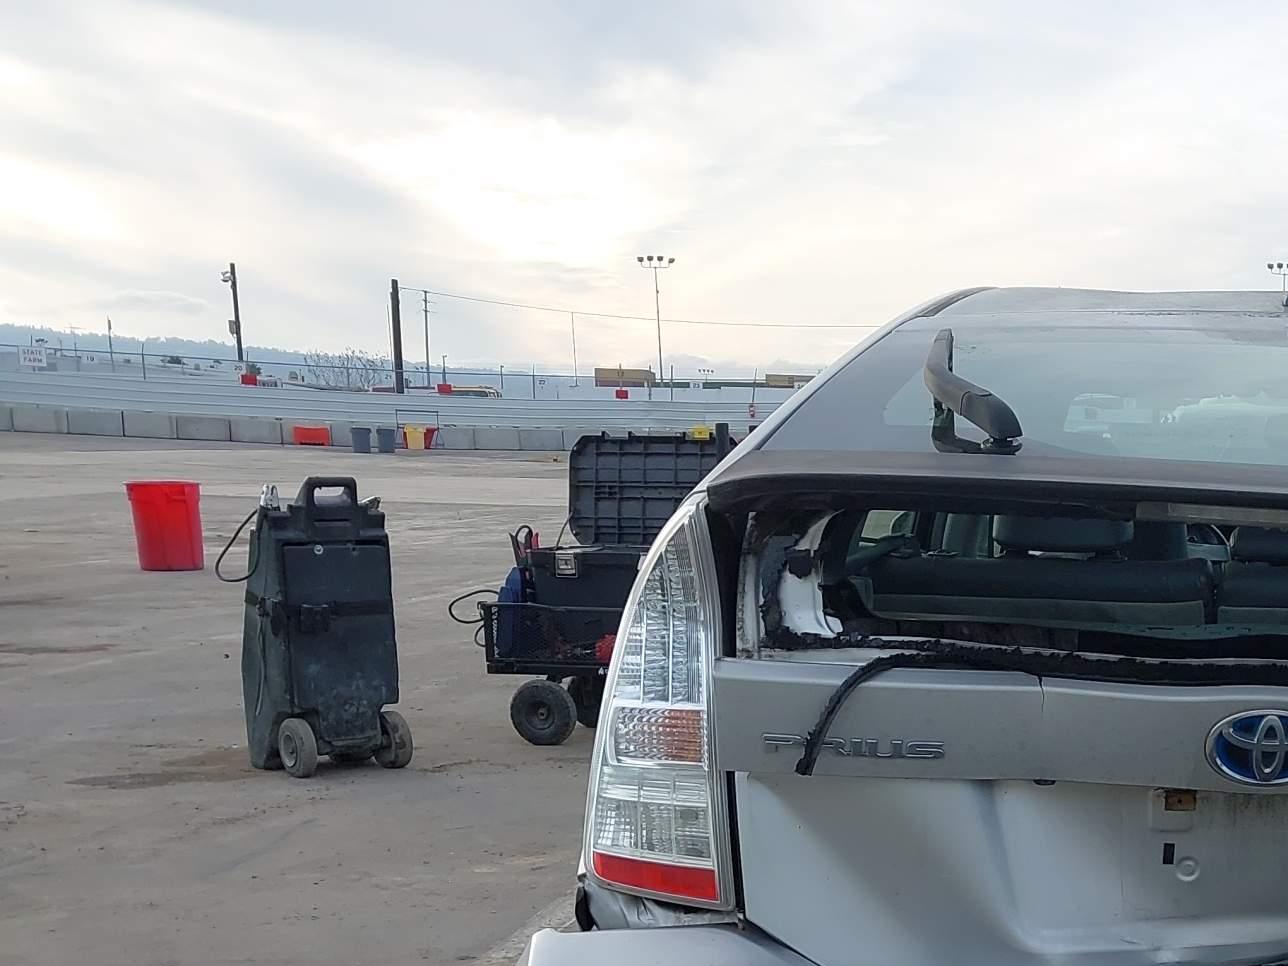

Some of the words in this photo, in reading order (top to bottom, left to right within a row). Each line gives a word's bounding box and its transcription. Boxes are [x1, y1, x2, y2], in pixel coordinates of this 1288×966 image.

[22, 348, 42, 356] STATE
[23, 356, 43, 364] FARM
[762, 732, 945, 759] PRIUS
